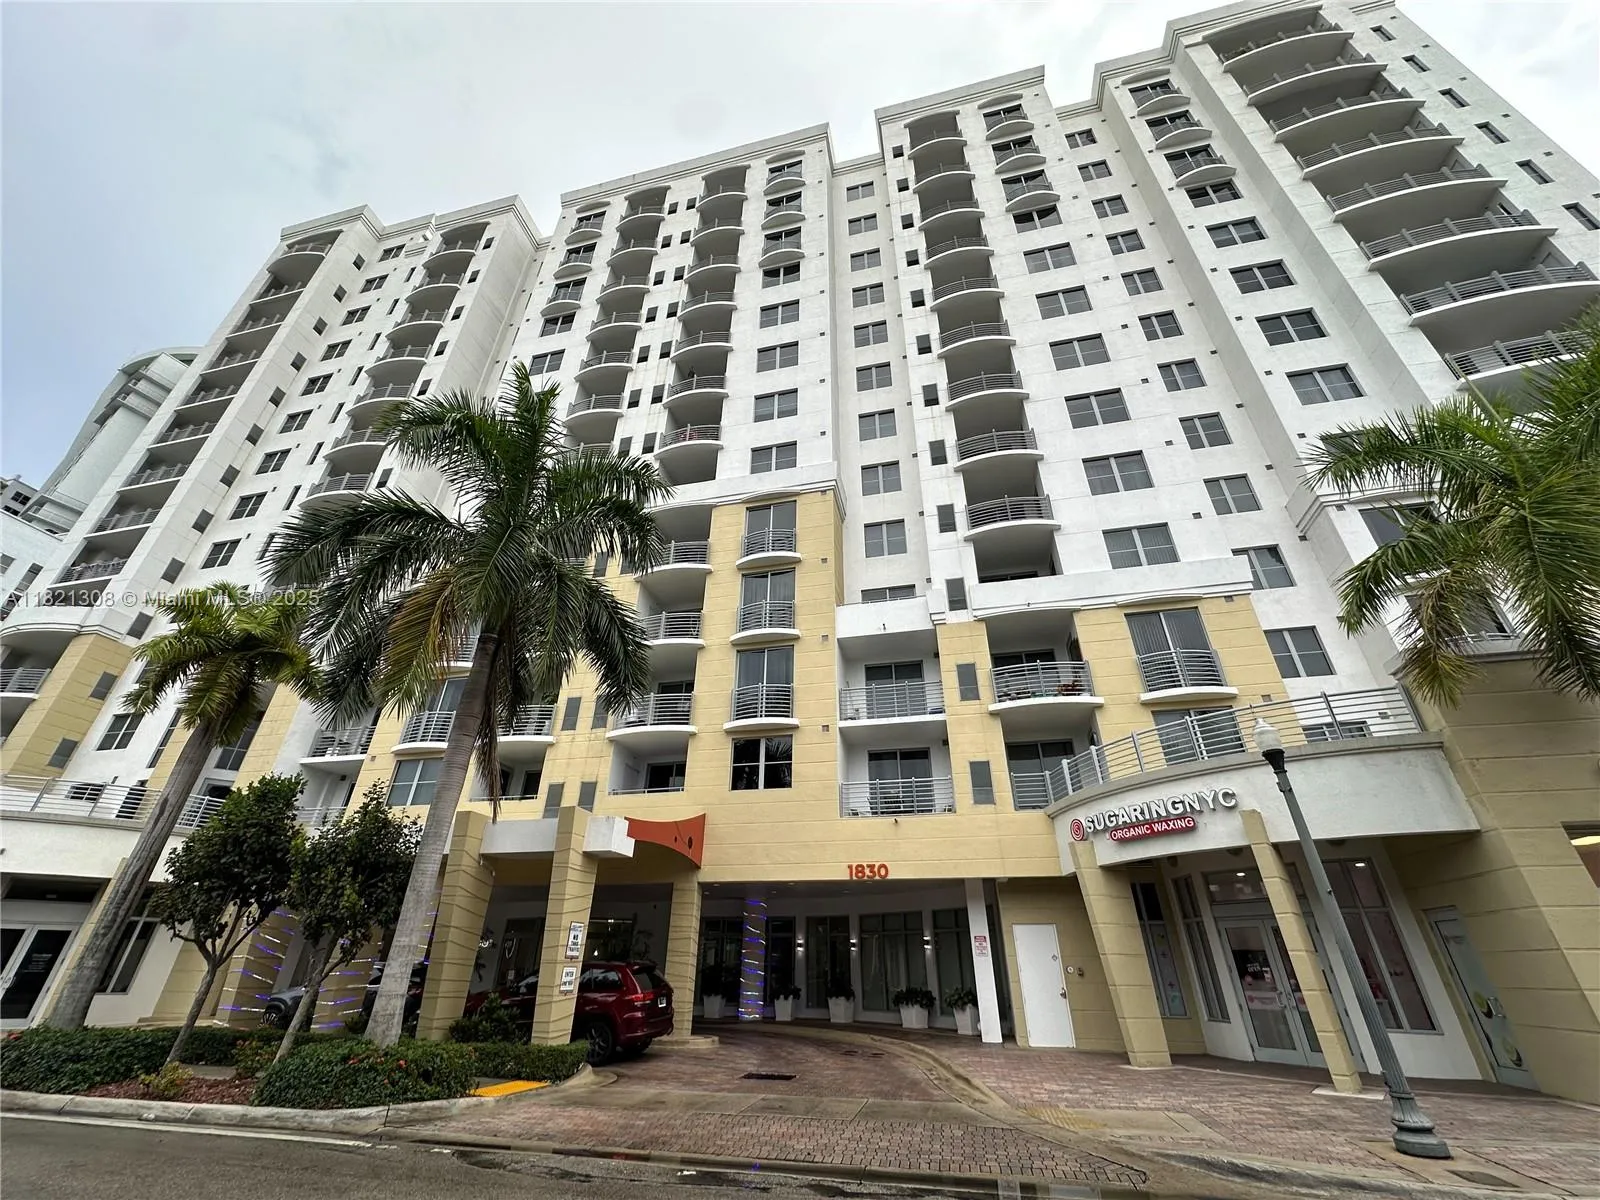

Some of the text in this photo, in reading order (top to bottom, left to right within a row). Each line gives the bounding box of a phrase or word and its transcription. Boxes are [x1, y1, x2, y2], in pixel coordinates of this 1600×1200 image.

[1085, 788, 1237, 833] SUGARINGNYC
[1111, 816, 1195, 841] ORGANIC WAXING
[847, 863, 889, 880] 1830
